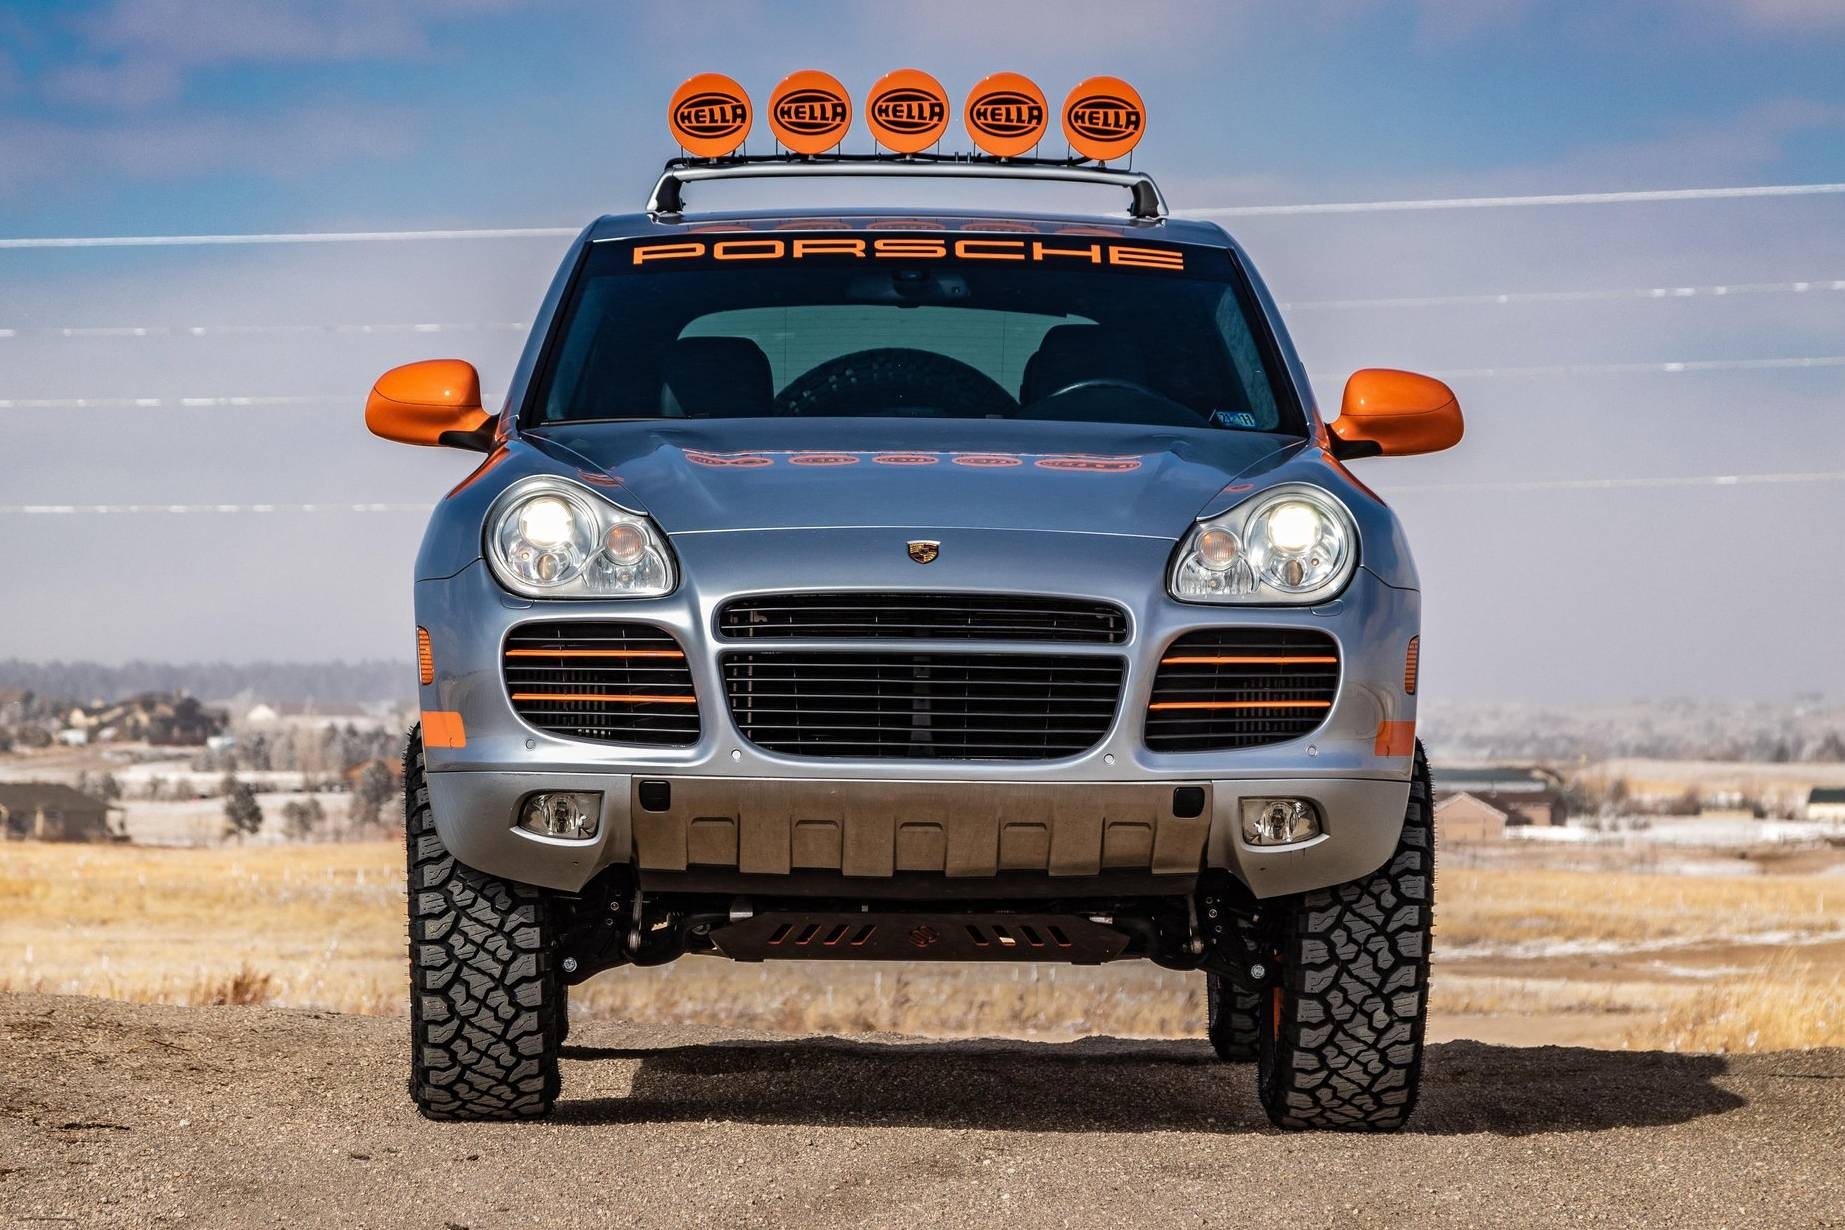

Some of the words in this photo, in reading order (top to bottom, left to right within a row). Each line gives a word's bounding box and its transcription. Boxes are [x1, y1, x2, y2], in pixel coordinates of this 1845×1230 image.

[680, 104, 747, 124] HELLA
[779, 103, 847, 122] HELLA
[877, 102, 944, 122] HELLA
[976, 105, 1043, 125] HELLA
[1073, 110, 1141, 131] HELLA
[633, 239, 1184, 270] PORSCHE
